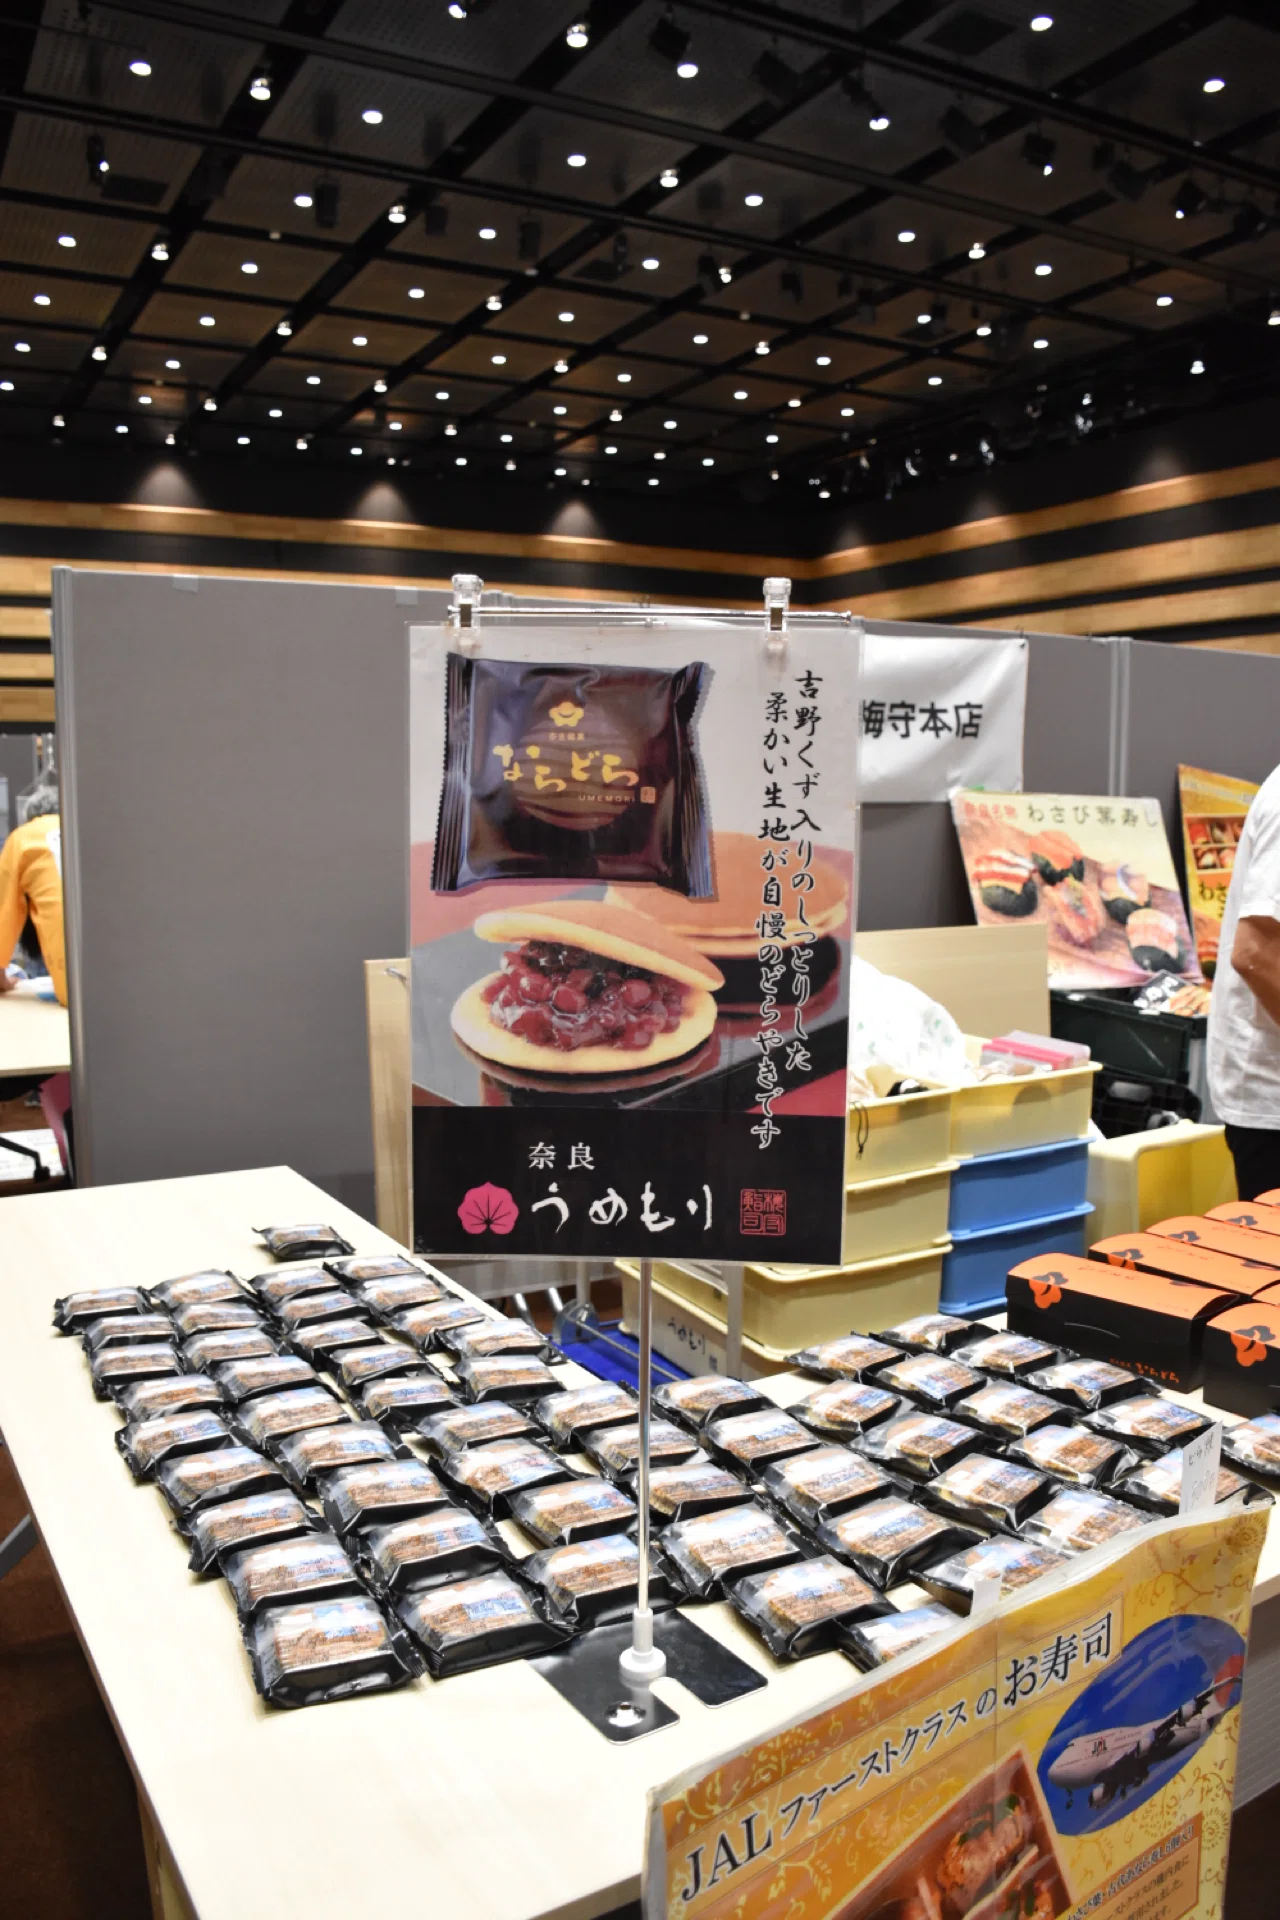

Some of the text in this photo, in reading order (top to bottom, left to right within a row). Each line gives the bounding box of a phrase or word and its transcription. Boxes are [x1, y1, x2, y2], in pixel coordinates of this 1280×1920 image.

[492, 744, 640, 792] ならどら
[578, 794, 636, 803] UMEMORI
[785, 669, 824, 1072] 吉野くず入りのしっとりした
[751, 691, 791, 1149] 柔かい生地が自慢のどらやきです
[528, 1141, 596, 1171] 奈良
[531, 1181, 713, 1234] うめもり
[1092, 1739, 1108, 1757] JAL
